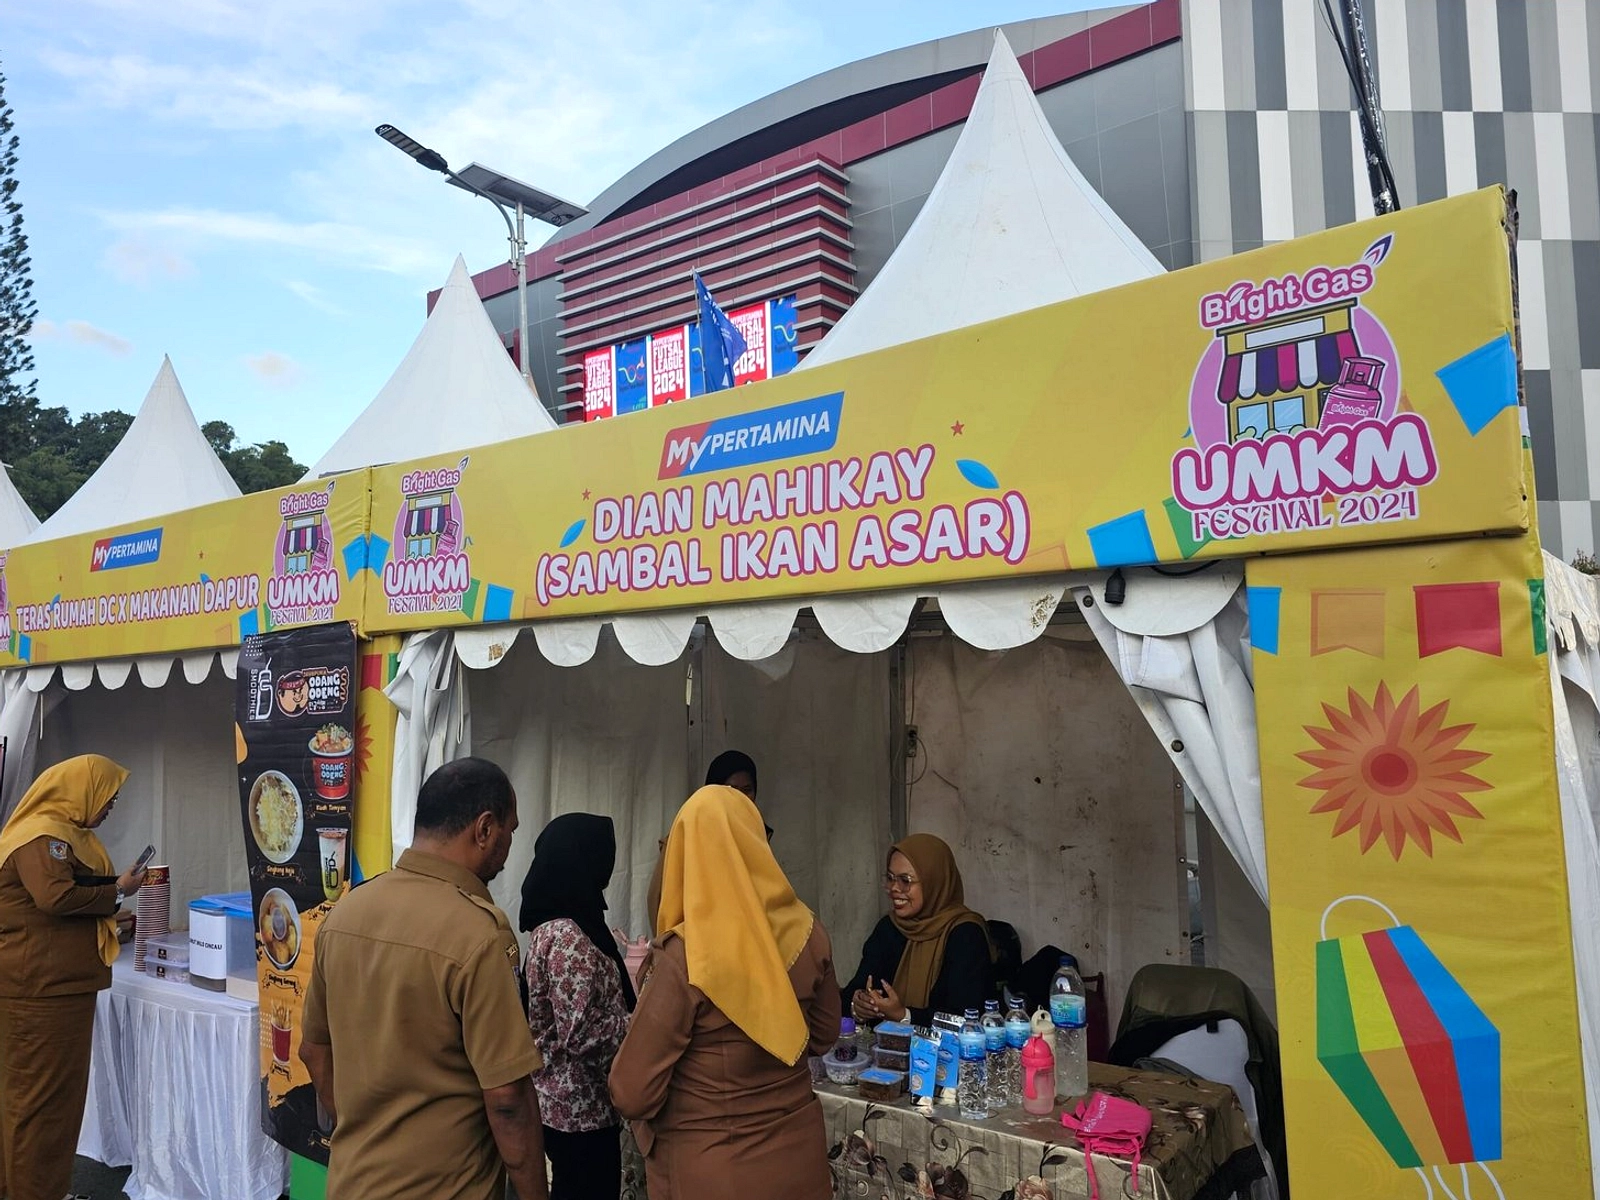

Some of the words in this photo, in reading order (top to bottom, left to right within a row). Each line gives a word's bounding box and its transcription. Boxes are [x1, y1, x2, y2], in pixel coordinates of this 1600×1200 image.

[1201, 284, 1301, 327] Bright
[1302, 265, 1375, 302] Gas
[653, 370, 684, 396] 2024
[402, 471, 436, 493] Bright
[437, 469, 460, 488] Gas
[1172, 414, 1438, 510] UMKM
[280, 494, 308, 515] Bright
[309, 491, 329, 509] Gas
[593, 486, 694, 544] DIAN
[703, 444, 935, 530] MAHIKAY
[1193, 499, 1332, 540] FESTIVAL
[1339, 490, 1416, 524] 2024
[536, 543, 711, 606] (SAMBAL
[721, 520, 839, 582] IKAN
[848, 491, 1030, 570] ASAR)
[267, 569, 339, 610] UMKM
[384, 553, 471, 597] UMKM
[16, 602, 51, 633] TERAS
[53, 597, 96, 629] RUMAH
[98, 593, 116, 625] DC
[118, 593, 127, 623] X
[129, 582, 201, 623] MAKANAN
[203, 573, 260, 613] DAPUR
[388, 595, 434, 613] FESTIVAL
[309, 673, 340, 687] ODANG
[309, 686, 340, 700] ODENG
